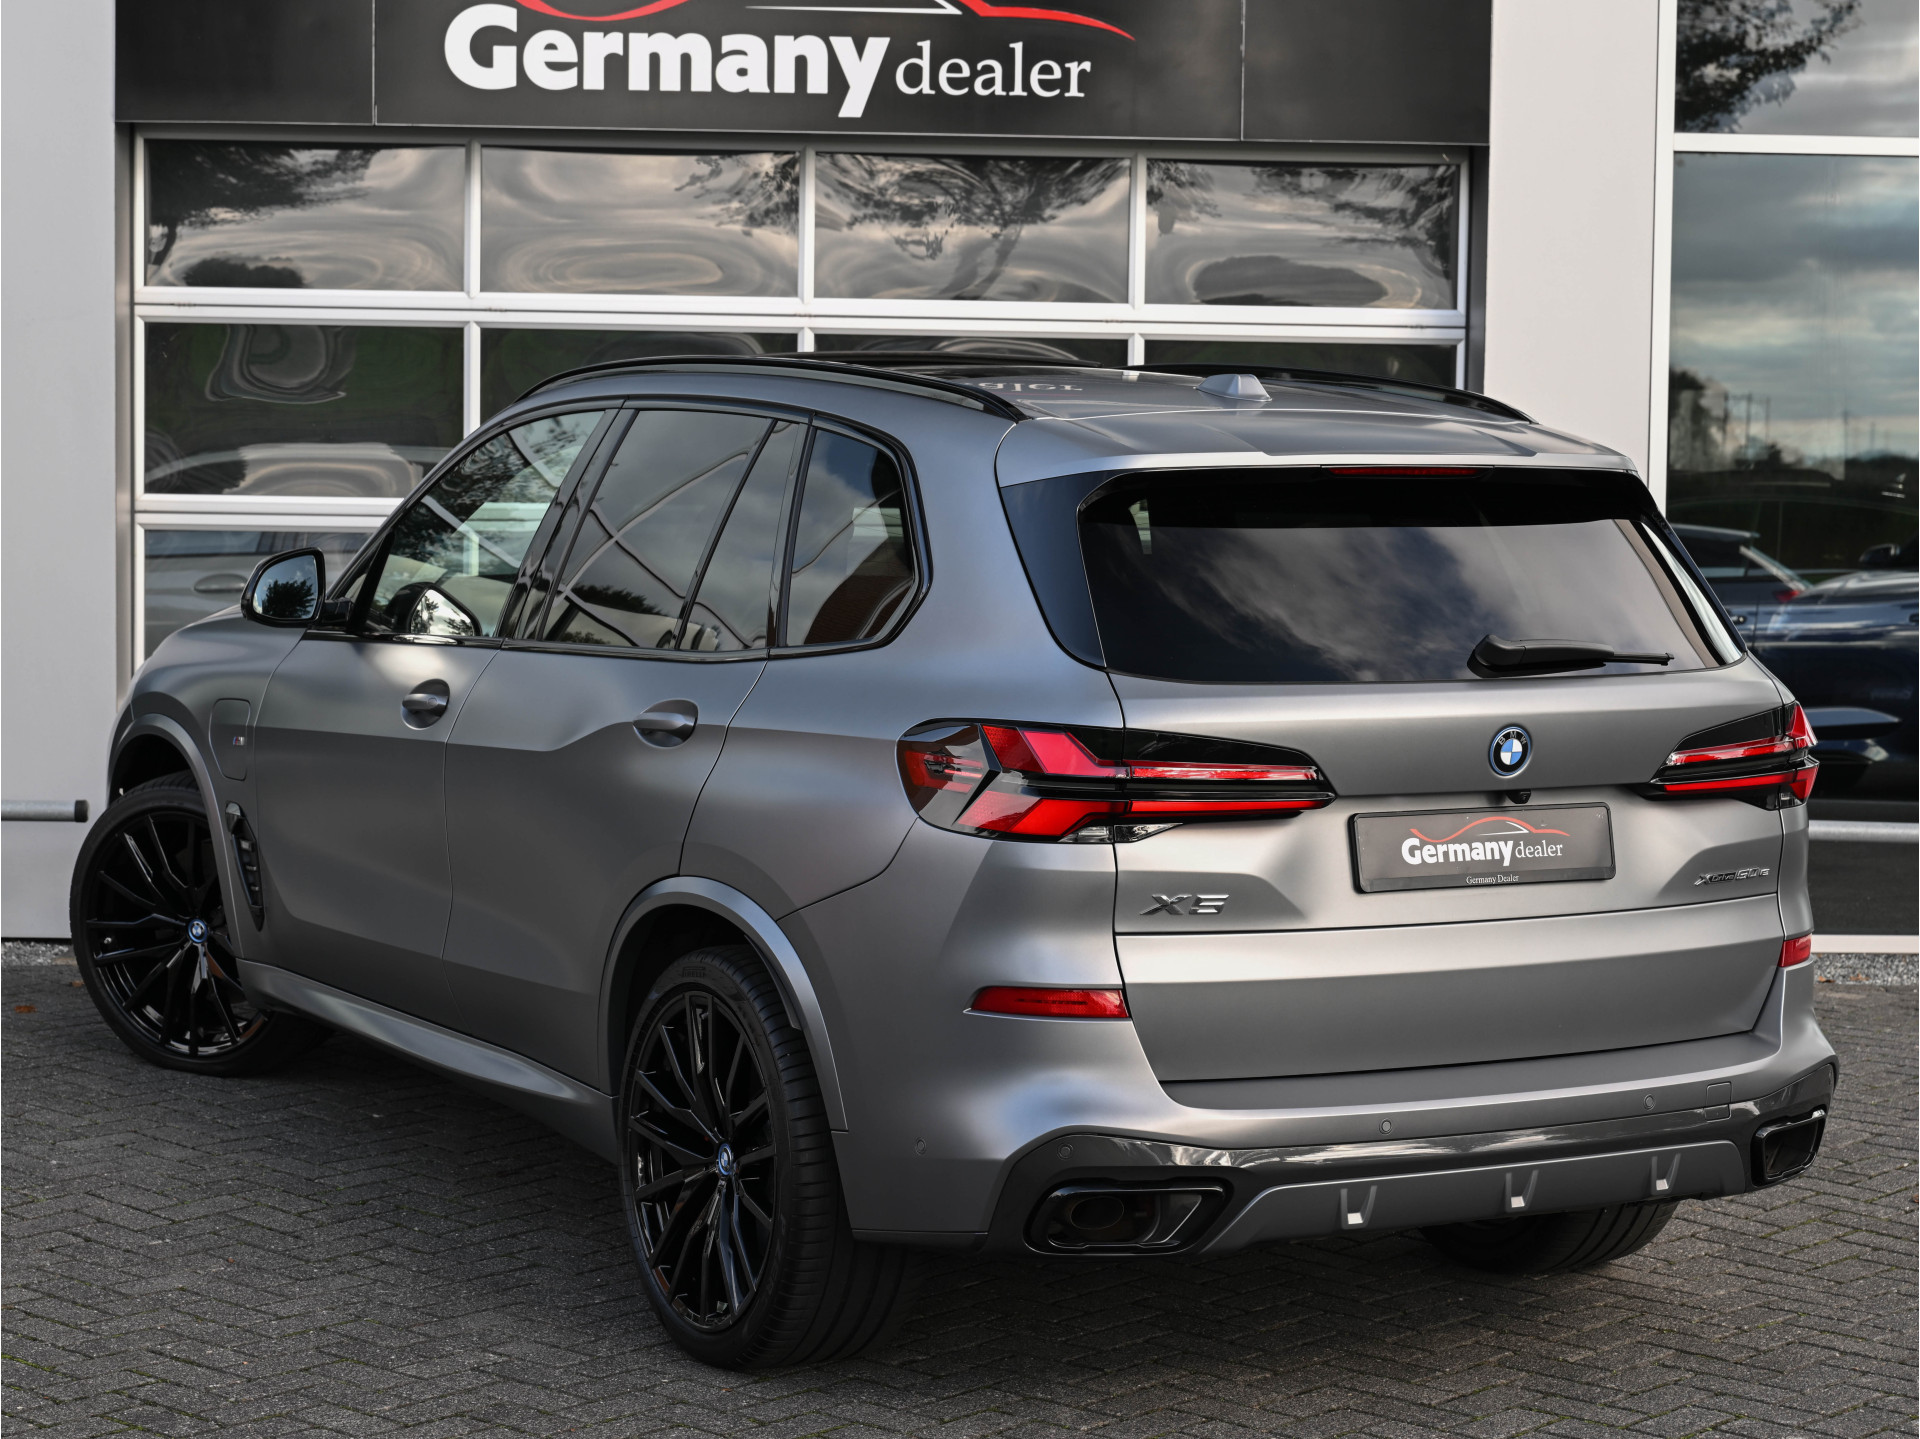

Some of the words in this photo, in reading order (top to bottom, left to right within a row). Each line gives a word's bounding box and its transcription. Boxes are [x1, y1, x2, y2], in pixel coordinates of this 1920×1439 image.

[443, 3, 891, 118] Germany
[895, 41, 1092, 98] dealer
[1401, 837, 1513, 867] Germany
[1515, 839, 1563, 858] dealer
[1466, 875, 1497, 885] Germany
[1497, 874, 1520, 883] Dealer
[1140, 894, 1230, 915] X5
